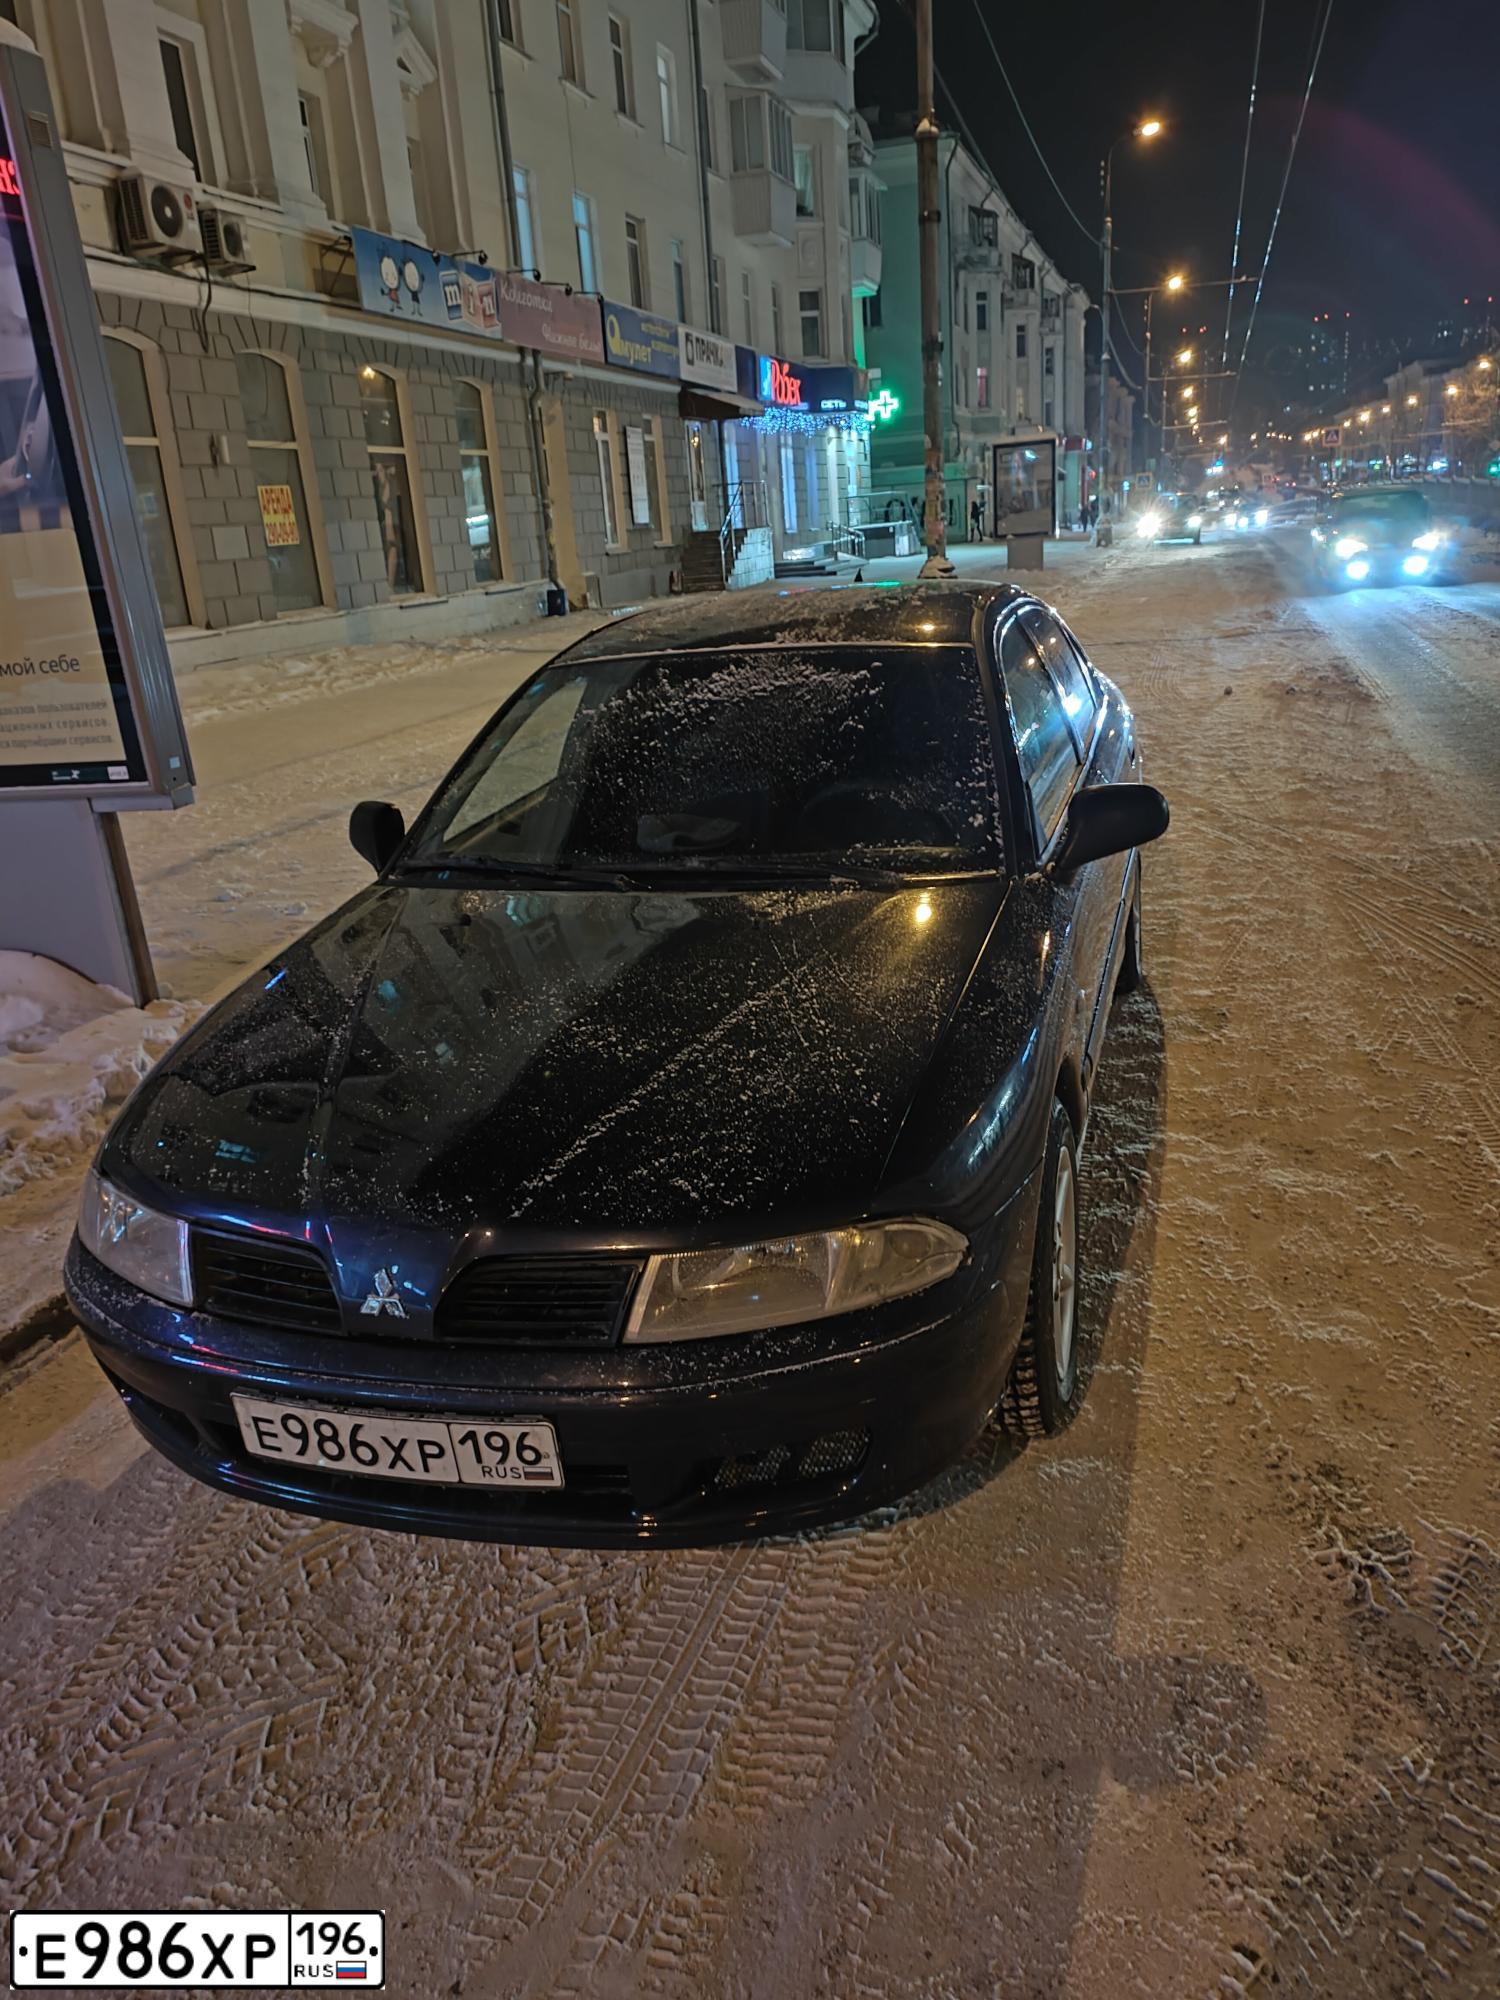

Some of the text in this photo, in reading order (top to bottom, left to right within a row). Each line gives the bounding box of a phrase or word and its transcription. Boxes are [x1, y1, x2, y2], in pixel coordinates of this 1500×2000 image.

[501, 279, 552, 313] Колготки
[260, 487, 292, 514] АРЕНДА
[39, 654, 80, 674] себе
[458, 1429, 542, 1467] 196
[481, 1464, 523, 1480] RUS
